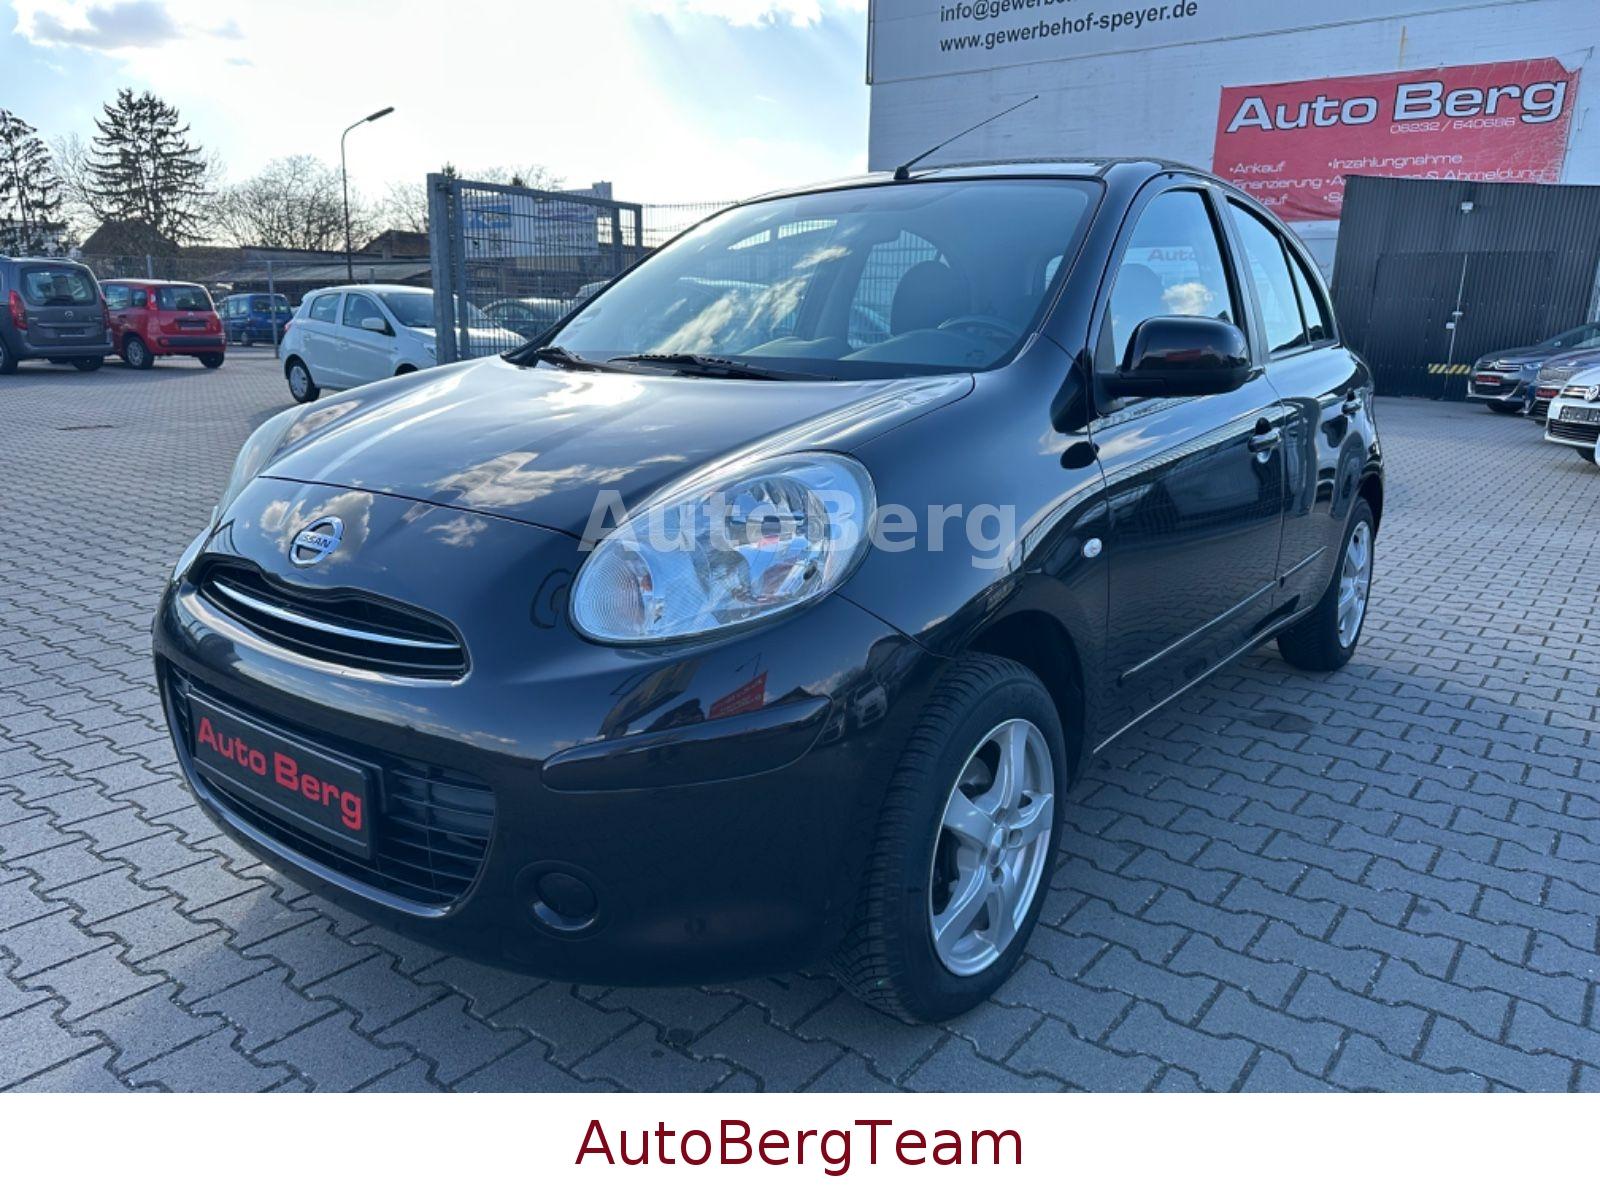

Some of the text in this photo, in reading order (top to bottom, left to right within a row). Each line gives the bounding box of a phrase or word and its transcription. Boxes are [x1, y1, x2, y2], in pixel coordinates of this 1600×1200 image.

[940, 0, 1198, 52] www.gewerbehof-speyer.de
[1225, 80, 1568, 134] Auto Berg
[1234, 161, 1286, 174] Ankauf
[1332, 153, 1463, 169] Inzahlungnahme
[198, 717, 363, 831] Auto Berg
